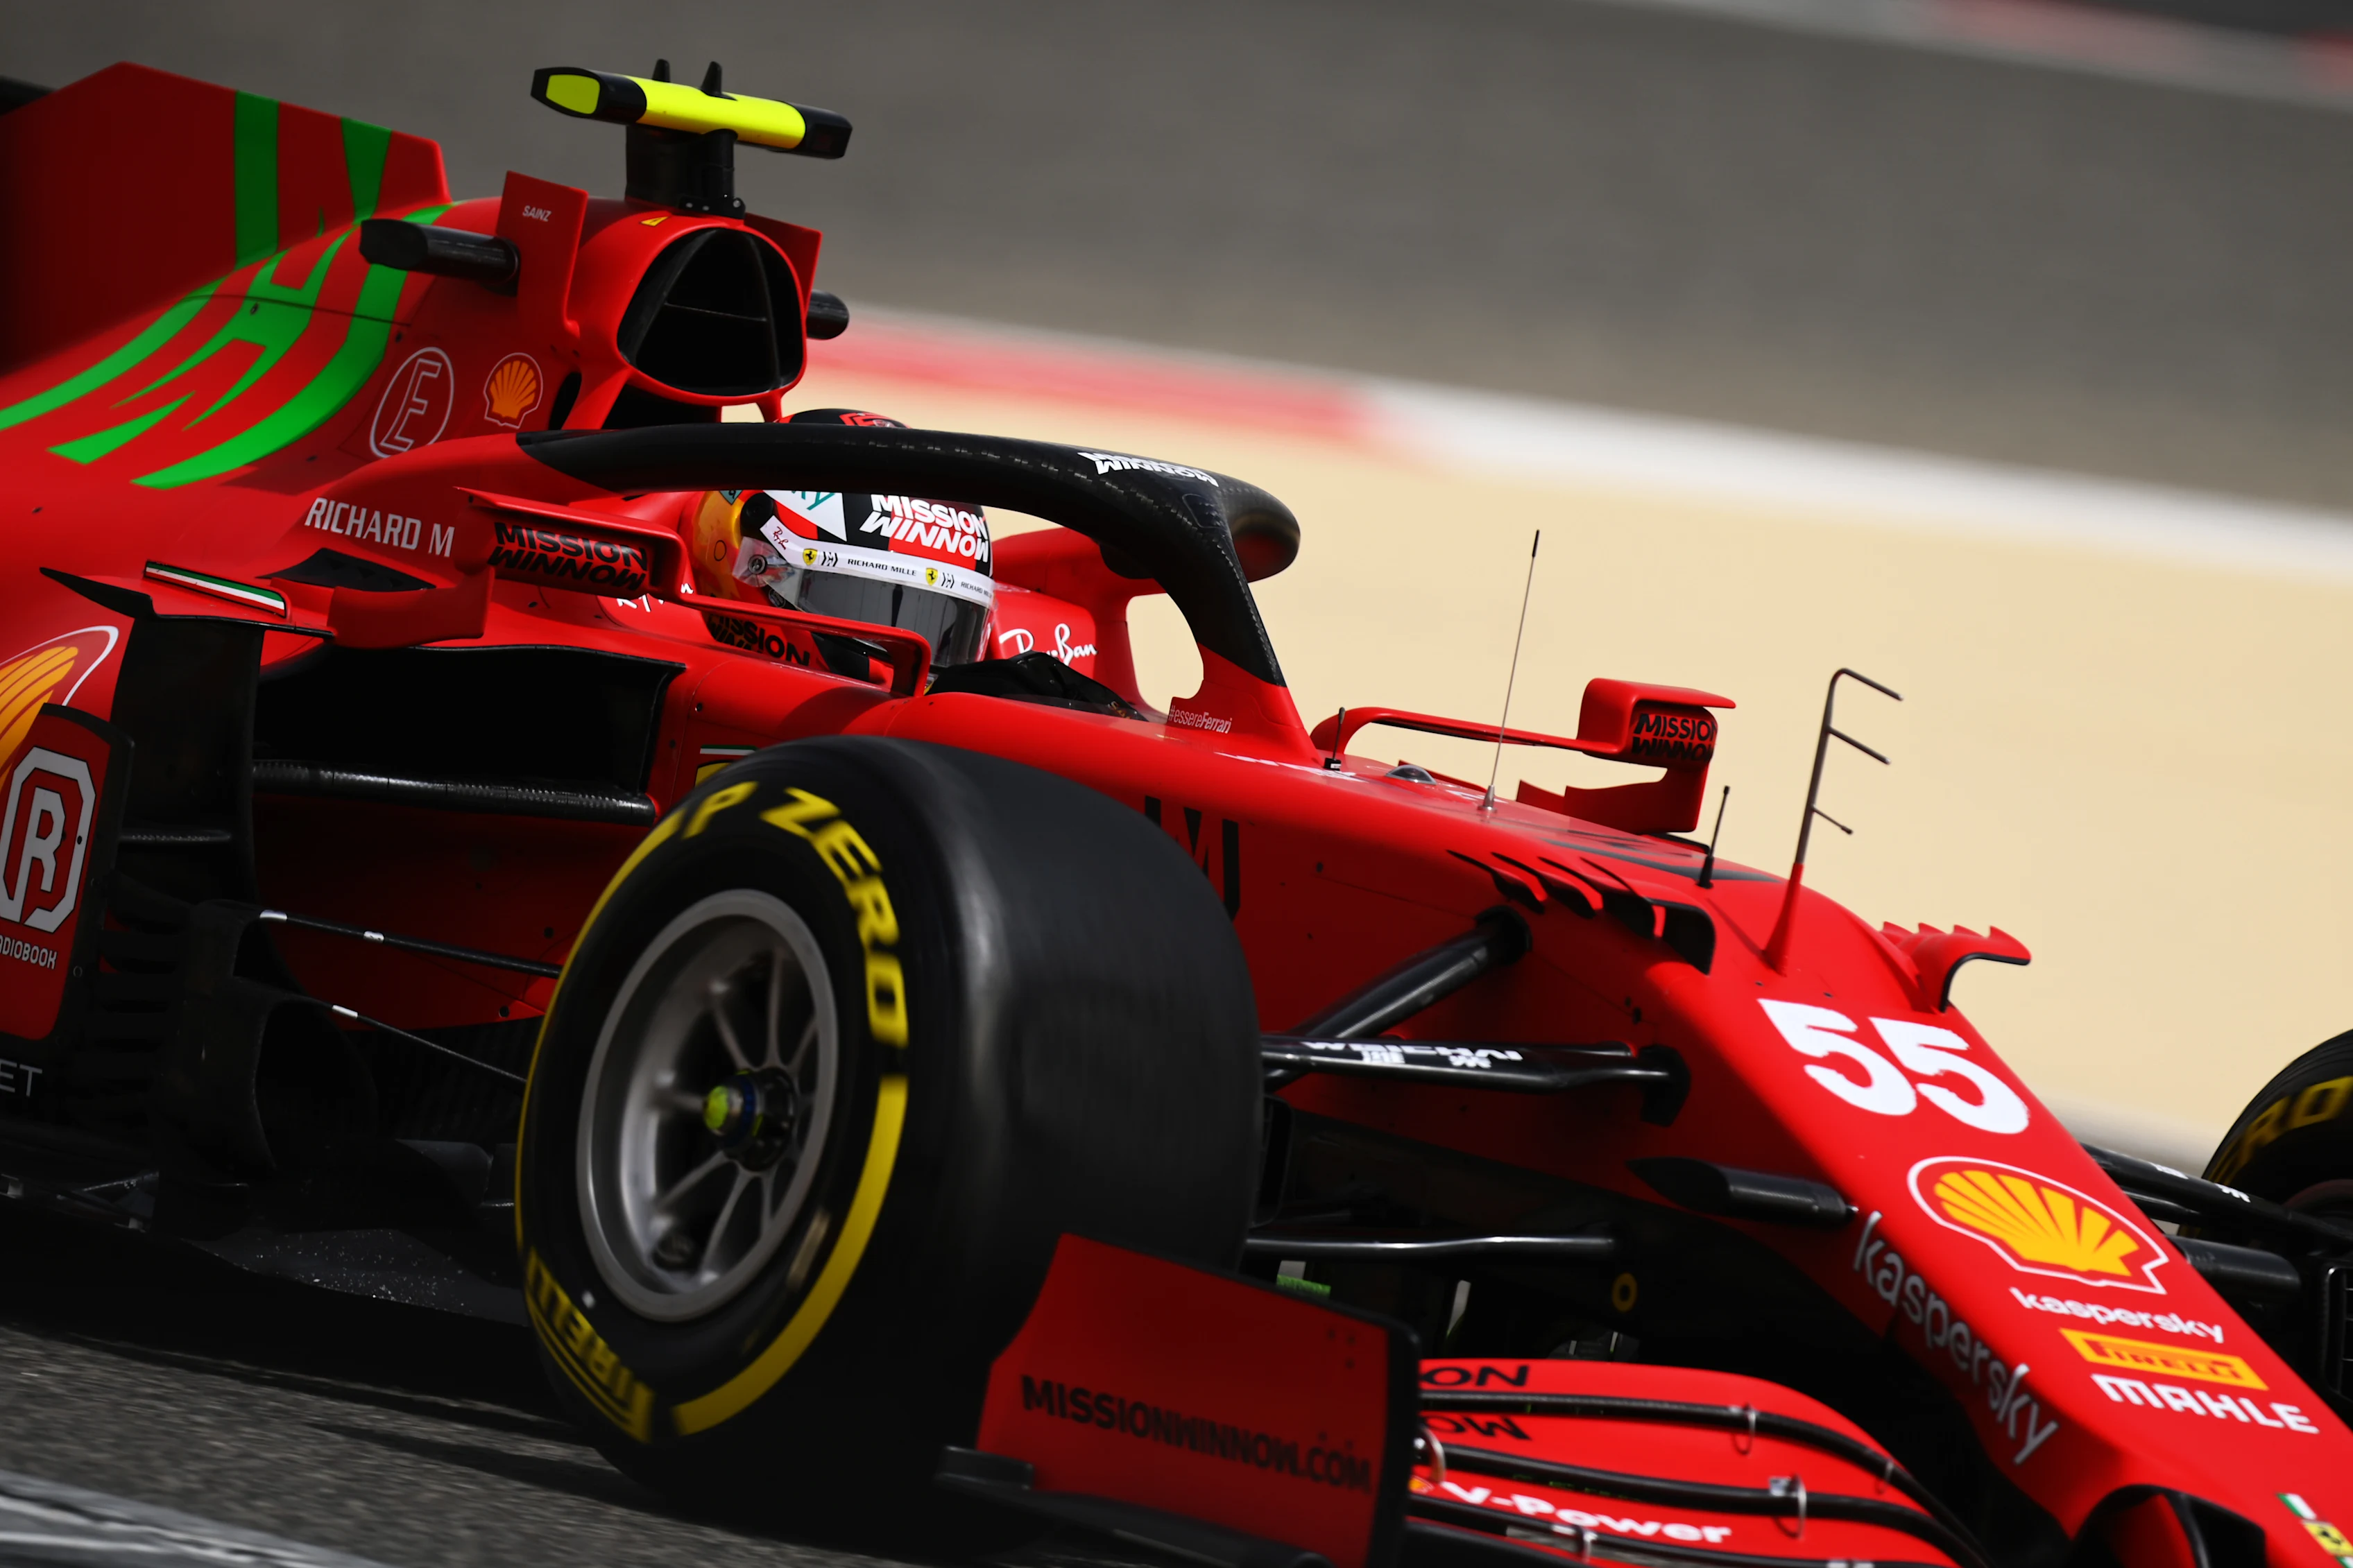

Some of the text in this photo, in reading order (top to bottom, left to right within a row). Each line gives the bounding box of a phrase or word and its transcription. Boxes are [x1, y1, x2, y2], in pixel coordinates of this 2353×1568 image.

[522, 205, 552, 222] SAINZ
[305, 497, 455, 558] RICHARD M
[859, 510, 989, 563] WINNOW
[871, 494, 989, 540] MISSION
[487, 545, 647, 592] WINNOW
[494, 522, 648, 571] MISSION
[848, 558, 917, 577] RICHARD MILLE
[960, 581, 983, 594] RICHARD
[1168, 704, 1233, 734] #essereFerrari
[681, 781, 909, 1049] P ZERO
[0, 934, 57, 970] DIOBOOK
[1756, 998, 2031, 1135] 55
[1853, 1210, 2059, 1465] kaspersky
[2009, 1286, 2225, 1344] kaspersky
[2090, 1372, 2320, 1435] MAHLE
[1021, 1375, 1372, 1495] MISSIONWINNOW.COM
[1439, 1481, 1732, 1543] V-Power
